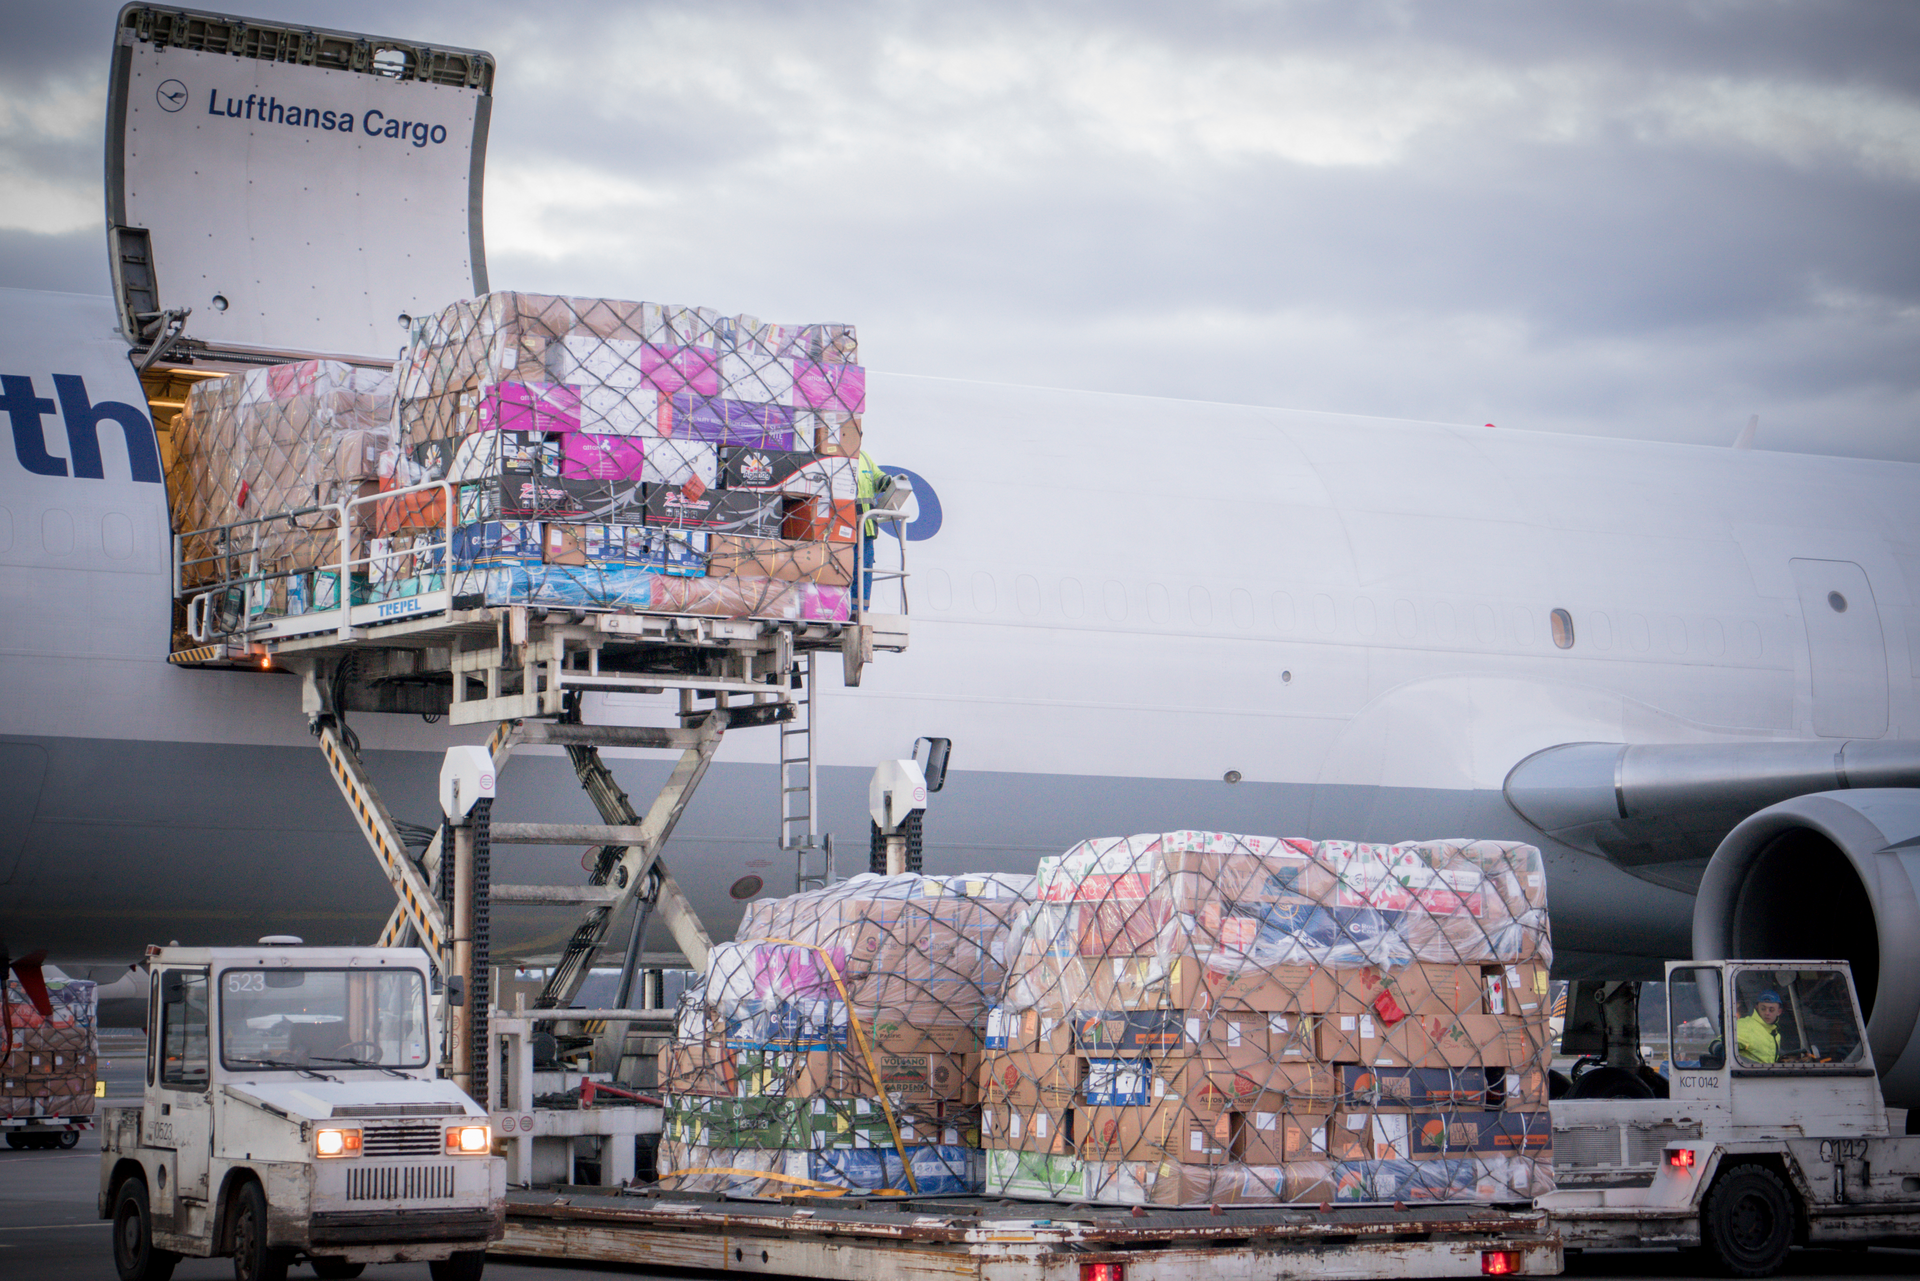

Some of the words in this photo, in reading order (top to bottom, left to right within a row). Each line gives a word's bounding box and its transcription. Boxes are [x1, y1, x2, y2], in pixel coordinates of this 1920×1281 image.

[208, 89, 354, 133] Lufthansa
[363, 109, 447, 148] Cargo
[378, 598, 422, 617] TREPEL
[228, 974, 264, 993] 523
[1680, 1076, 1697, 1088] KCT
[1698, 1076, 1719, 1089] 0142
[154, 1121, 173, 1141] 0523
[1820, 1138, 1869, 1163] 0142
